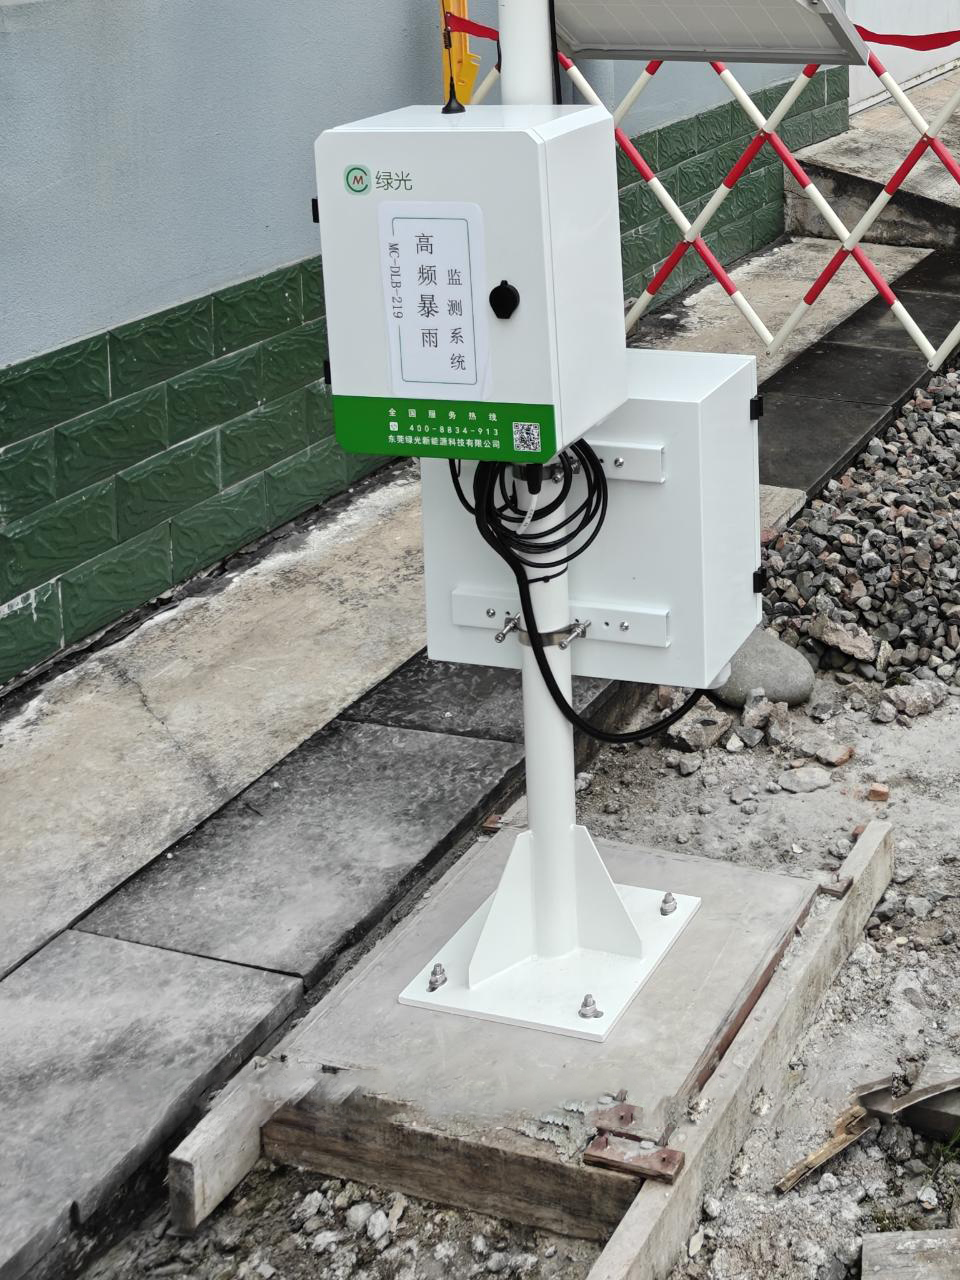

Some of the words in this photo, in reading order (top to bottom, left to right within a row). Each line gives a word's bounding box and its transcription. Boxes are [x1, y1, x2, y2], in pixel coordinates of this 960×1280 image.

[375, 170, 413, 191] 绿光
[388, 242, 404, 320] MC-DLB-219
[414, 232, 439, 349] 高频暴雨
[447, 268, 467, 371] 监测系统
[387, 434, 500, 449] 东莞绿光新能源科技有限公司
[409, 424, 499, 436] 400-8834-913
